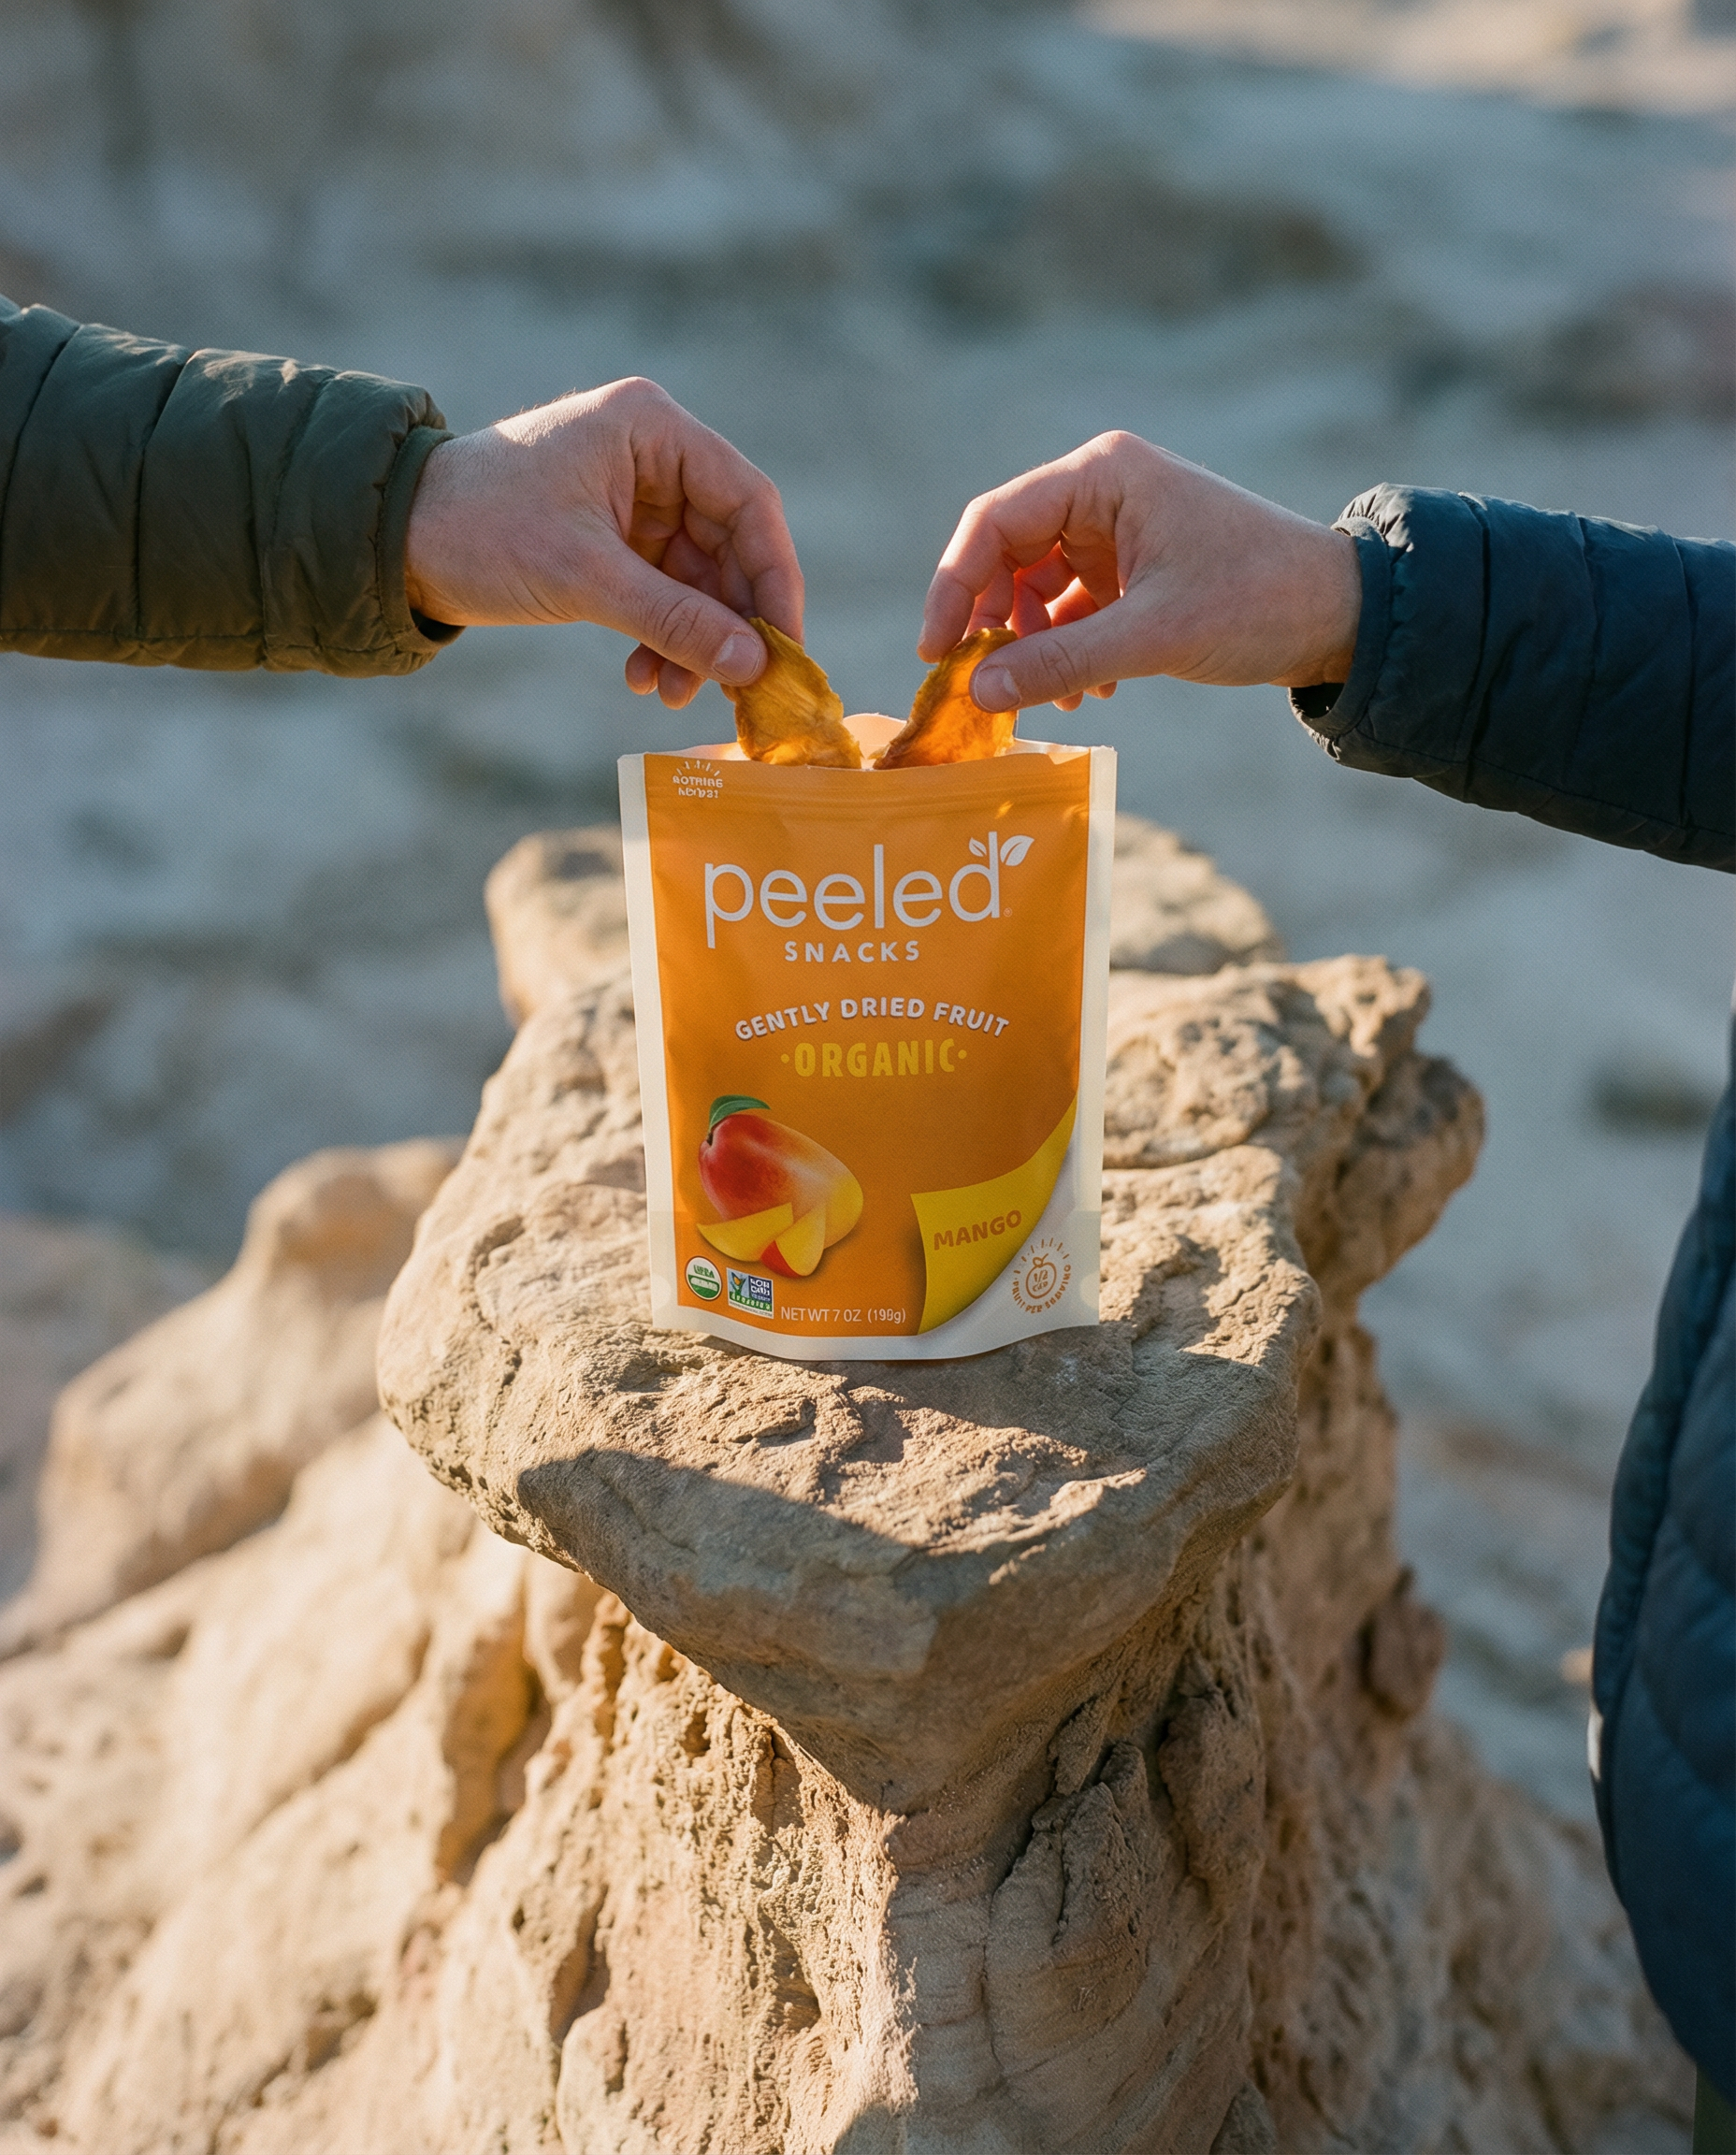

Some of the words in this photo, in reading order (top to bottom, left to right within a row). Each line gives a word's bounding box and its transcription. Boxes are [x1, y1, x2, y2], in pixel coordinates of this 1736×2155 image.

[704, 831, 1000, 949] peeled
[784, 940, 920, 963] SNACKS
[734, 1001, 831, 1041] GENTLY
[840, 996, 925, 1020] DRIED
[933, 1002, 1009, 1037] FRUIT
[793, 1037, 956, 1078] ORGANIC
[933, 1209, 1022, 1251] MANGO
[781, 1306, 805, 1322] NET
[807, 1308, 829, 1322] WT
[832, 1309, 841, 1322] 7
[844, 1309, 861, 1322] OZ
